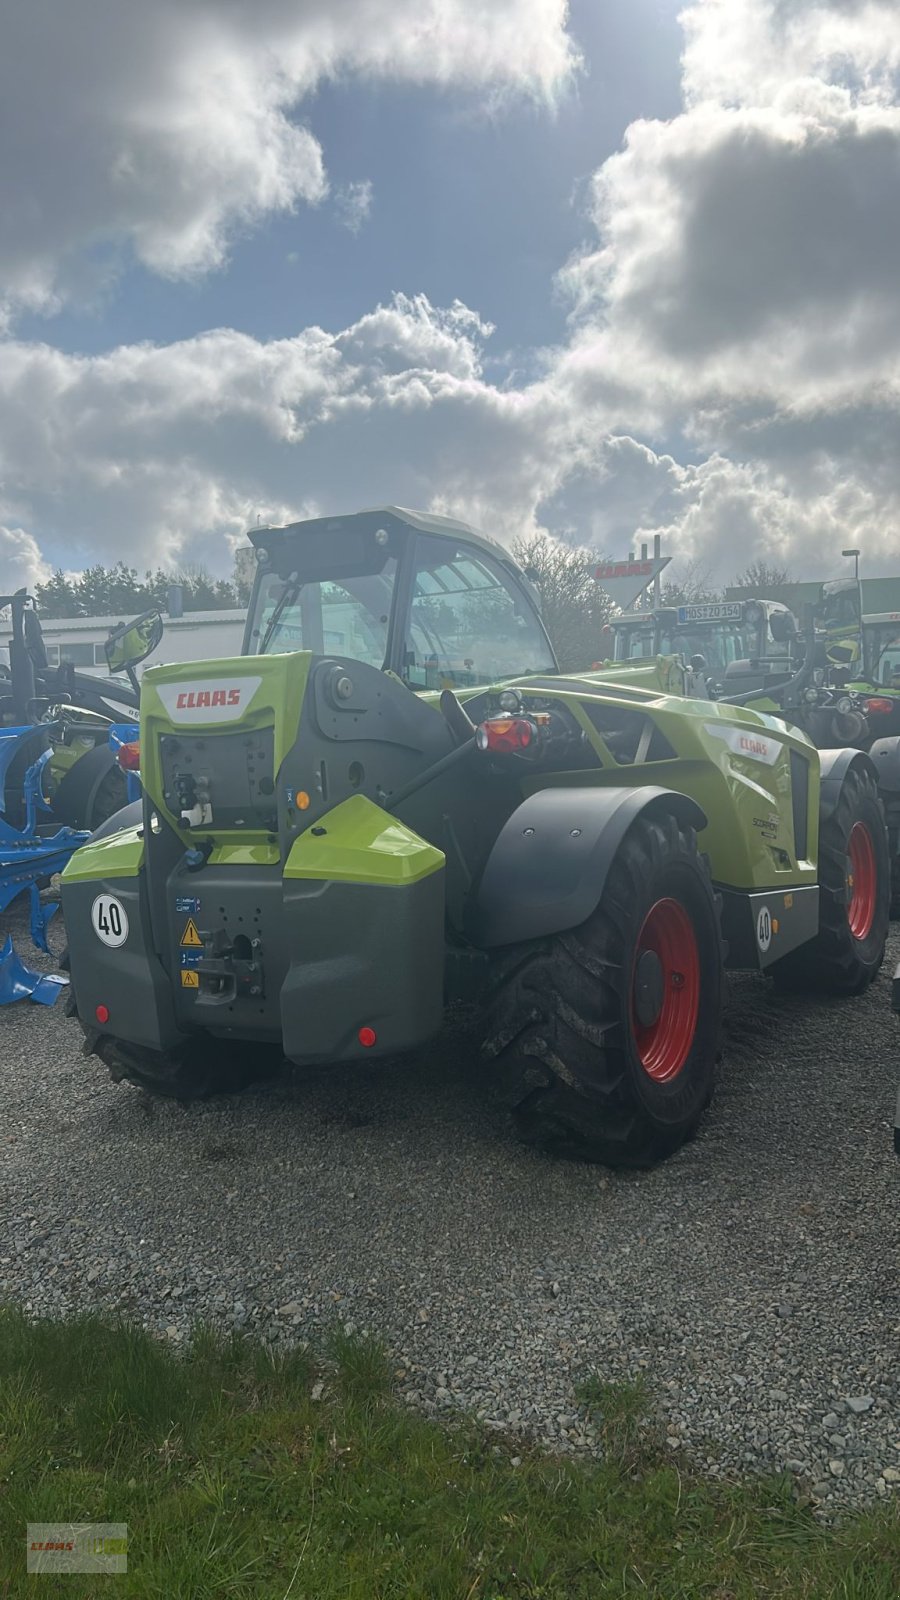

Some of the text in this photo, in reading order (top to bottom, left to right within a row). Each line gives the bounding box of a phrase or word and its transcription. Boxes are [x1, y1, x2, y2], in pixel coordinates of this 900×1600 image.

[594, 562, 654, 579] CLAAS
[721, 604, 739, 617] 154
[176, 689, 241, 709] CLAAS
[740, 736, 768, 756] CLAAS
[98, 902, 122, 936] 40
[759, 911, 770, 943] 40
